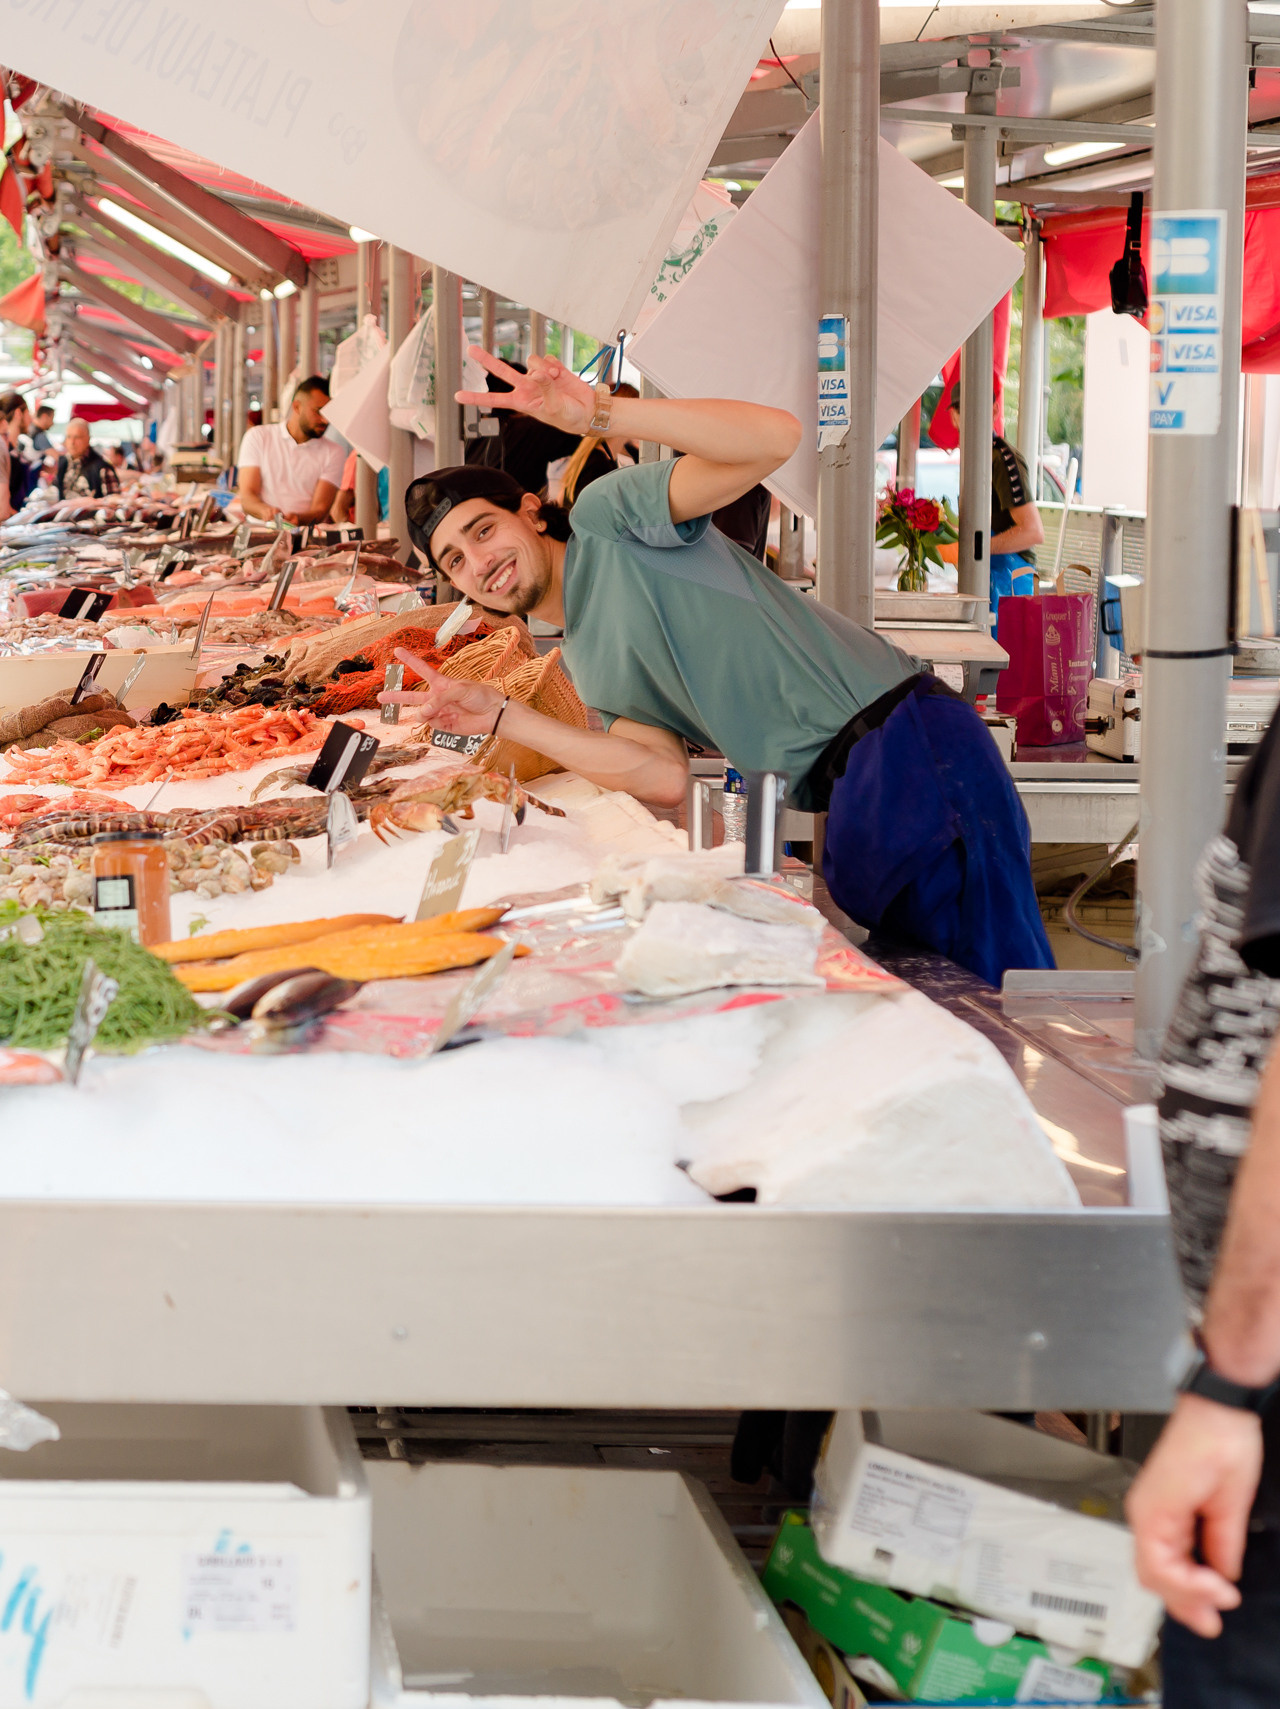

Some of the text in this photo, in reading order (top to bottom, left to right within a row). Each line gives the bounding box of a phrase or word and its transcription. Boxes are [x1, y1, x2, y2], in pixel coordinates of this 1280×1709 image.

[1174, 305, 1217, 321] VISA
[1173, 344, 1216, 360] VISA
[821, 379, 846, 390] VISA
[821, 405, 847, 417] VISA
[433, 733, 461, 747] CRUE
